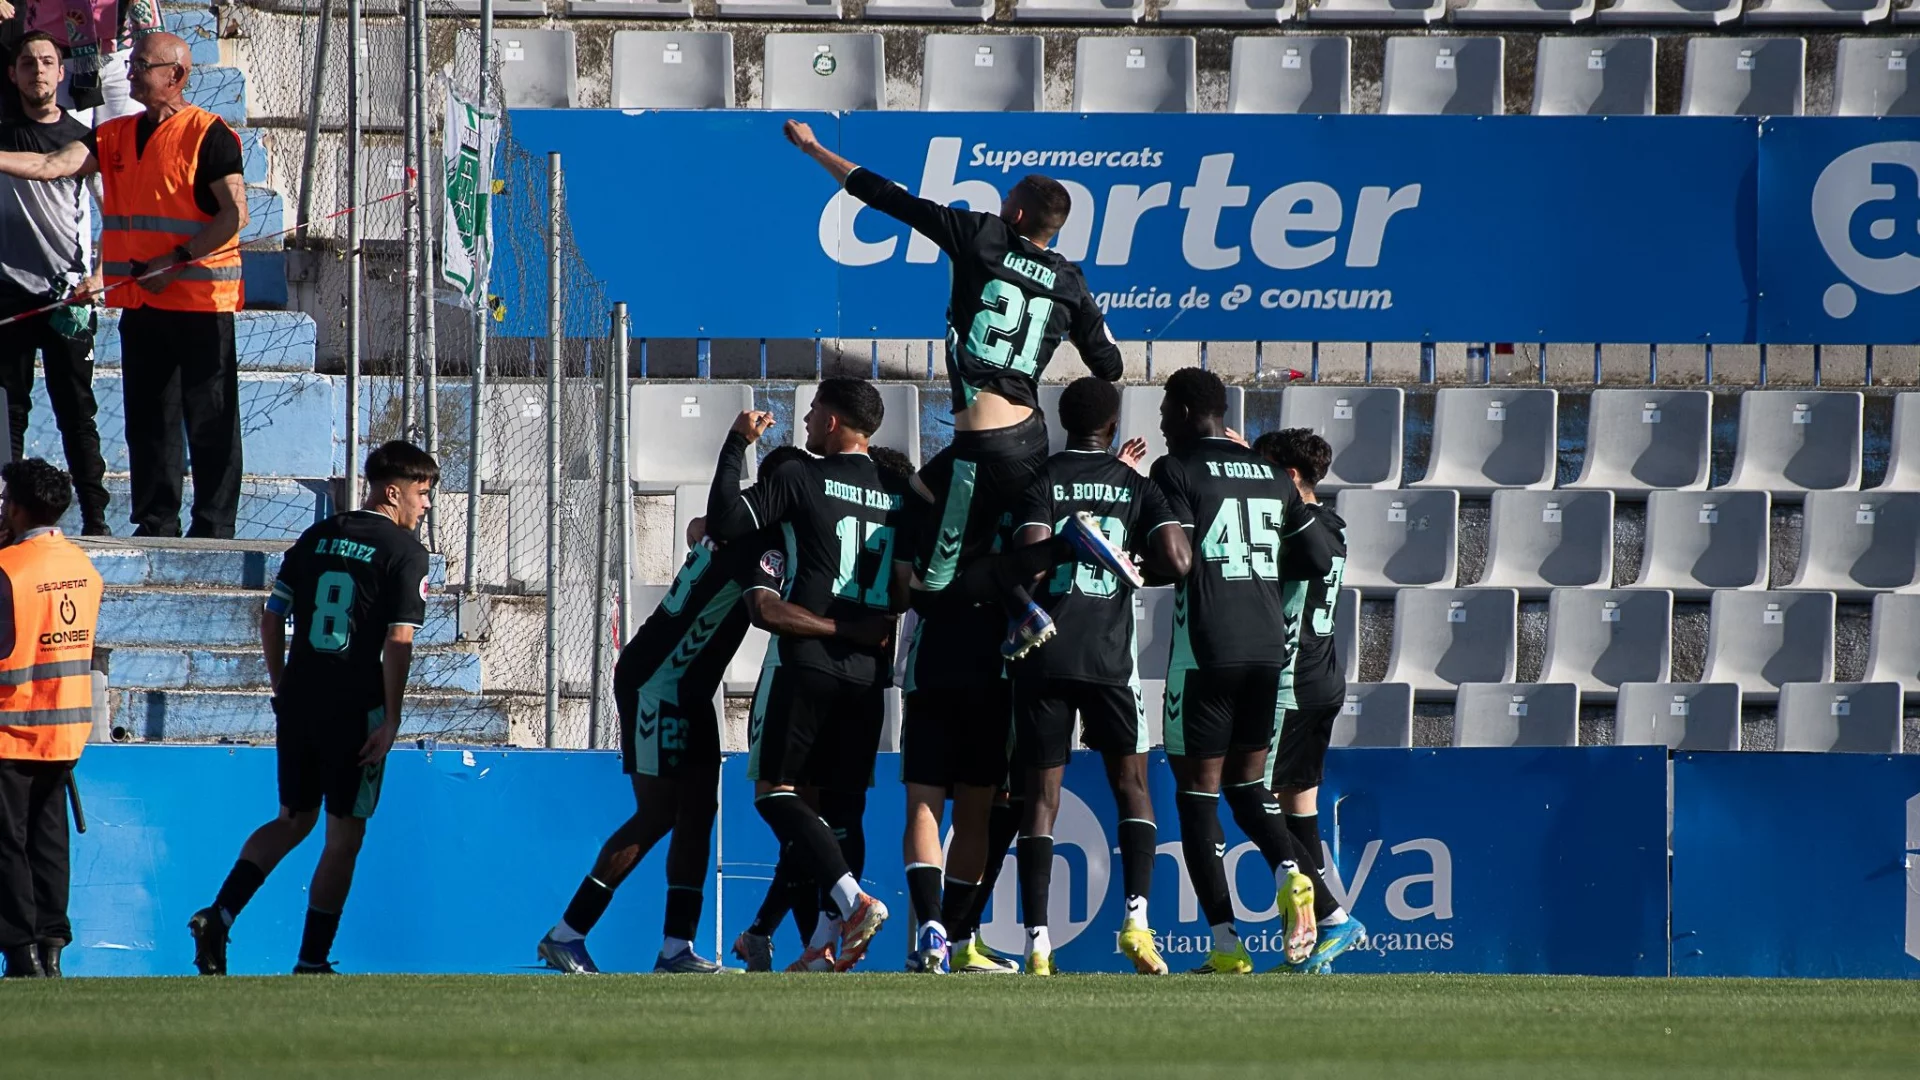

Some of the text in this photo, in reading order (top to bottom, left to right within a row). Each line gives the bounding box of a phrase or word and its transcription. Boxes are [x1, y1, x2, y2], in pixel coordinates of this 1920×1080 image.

[969, 142, 1164, 173] Supermercats
[1090, 285, 1394, 315] quícia de consum
[965, 279, 1054, 379] 21
[824, 478, 863, 505] RODRI
[1053, 484, 1070, 501] G.
[329, 538, 376, 563] PÉREZ
[1200, 498, 1283, 581] 45
[831, 515, 896, 609] 17
[308, 570, 356, 653] 8
[1346, 932, 1454, 957] açanes
